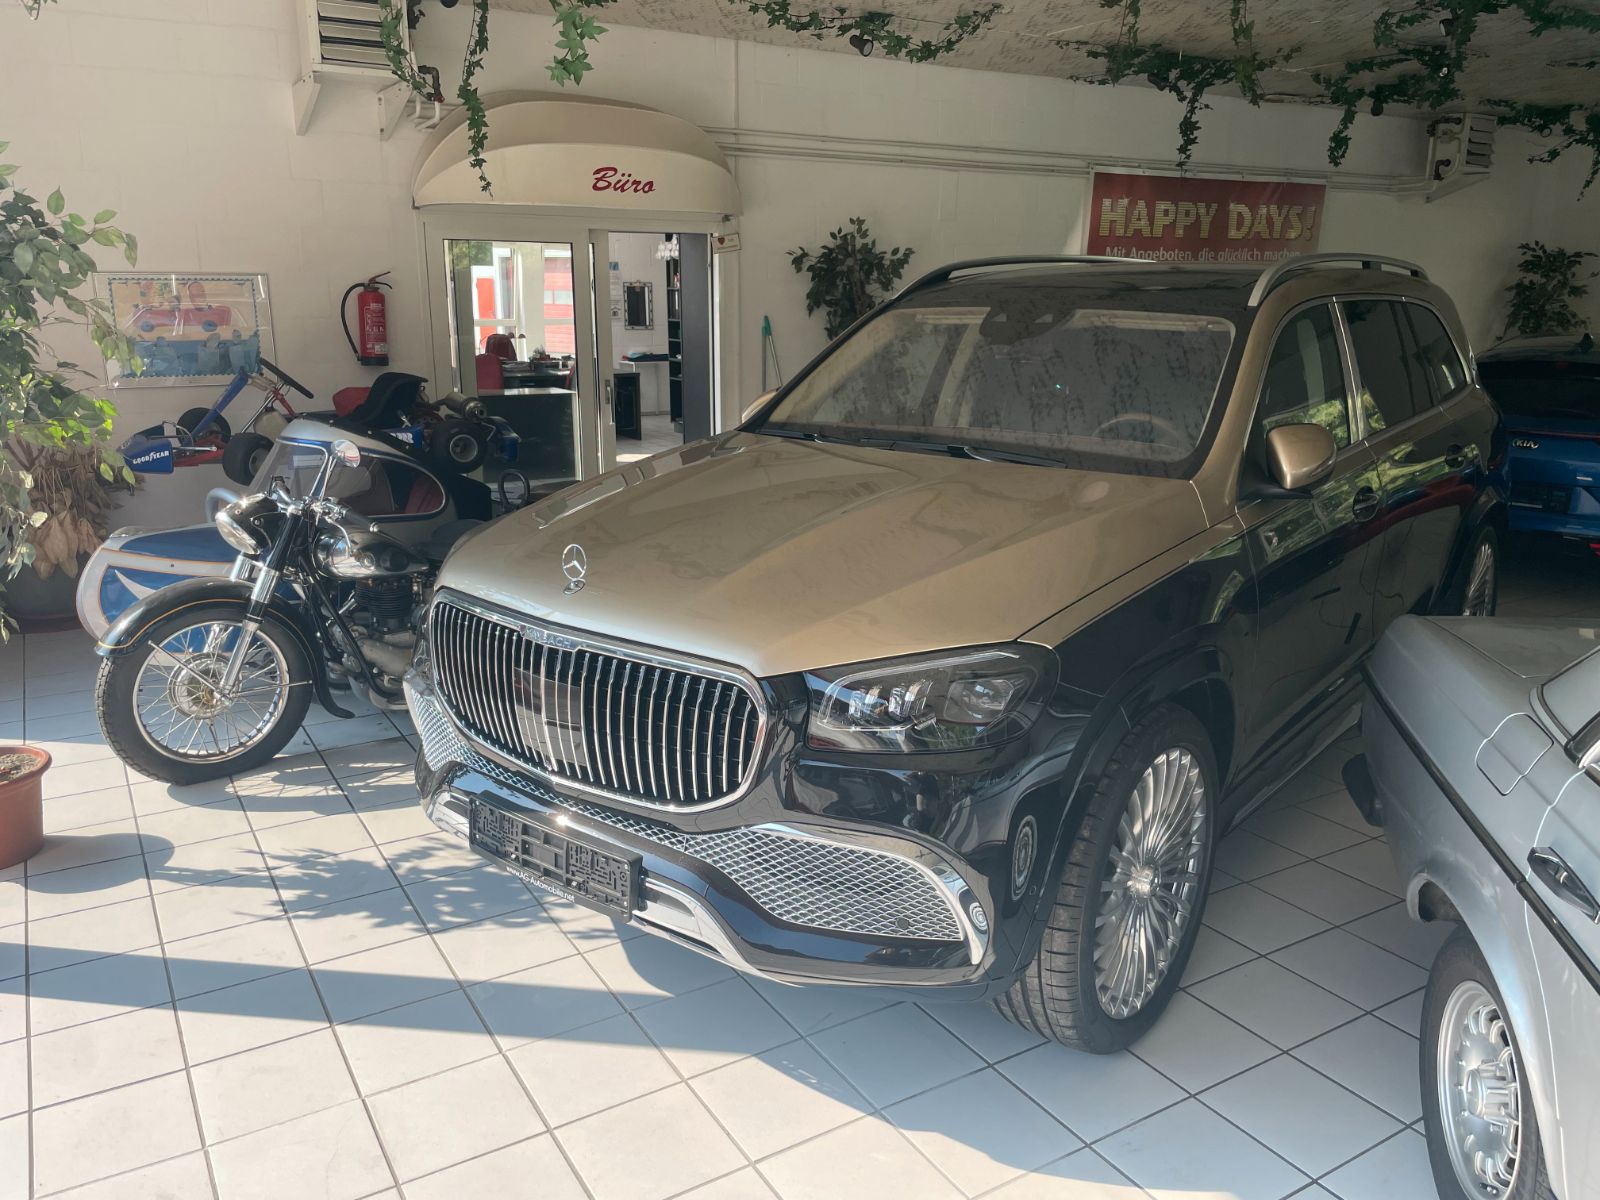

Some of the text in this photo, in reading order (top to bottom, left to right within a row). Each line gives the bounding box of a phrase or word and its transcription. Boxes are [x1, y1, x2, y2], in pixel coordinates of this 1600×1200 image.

[592, 166, 656, 194] Büro
[1098, 197, 1317, 242] HAPPY DAYS!
[1198, 247, 1215, 261] die
[1514, 439, 1535, 448] KIA
[132, 450, 170, 465] GOODYEAR
[506, 865, 575, 902] www.AG-Automobile.net
